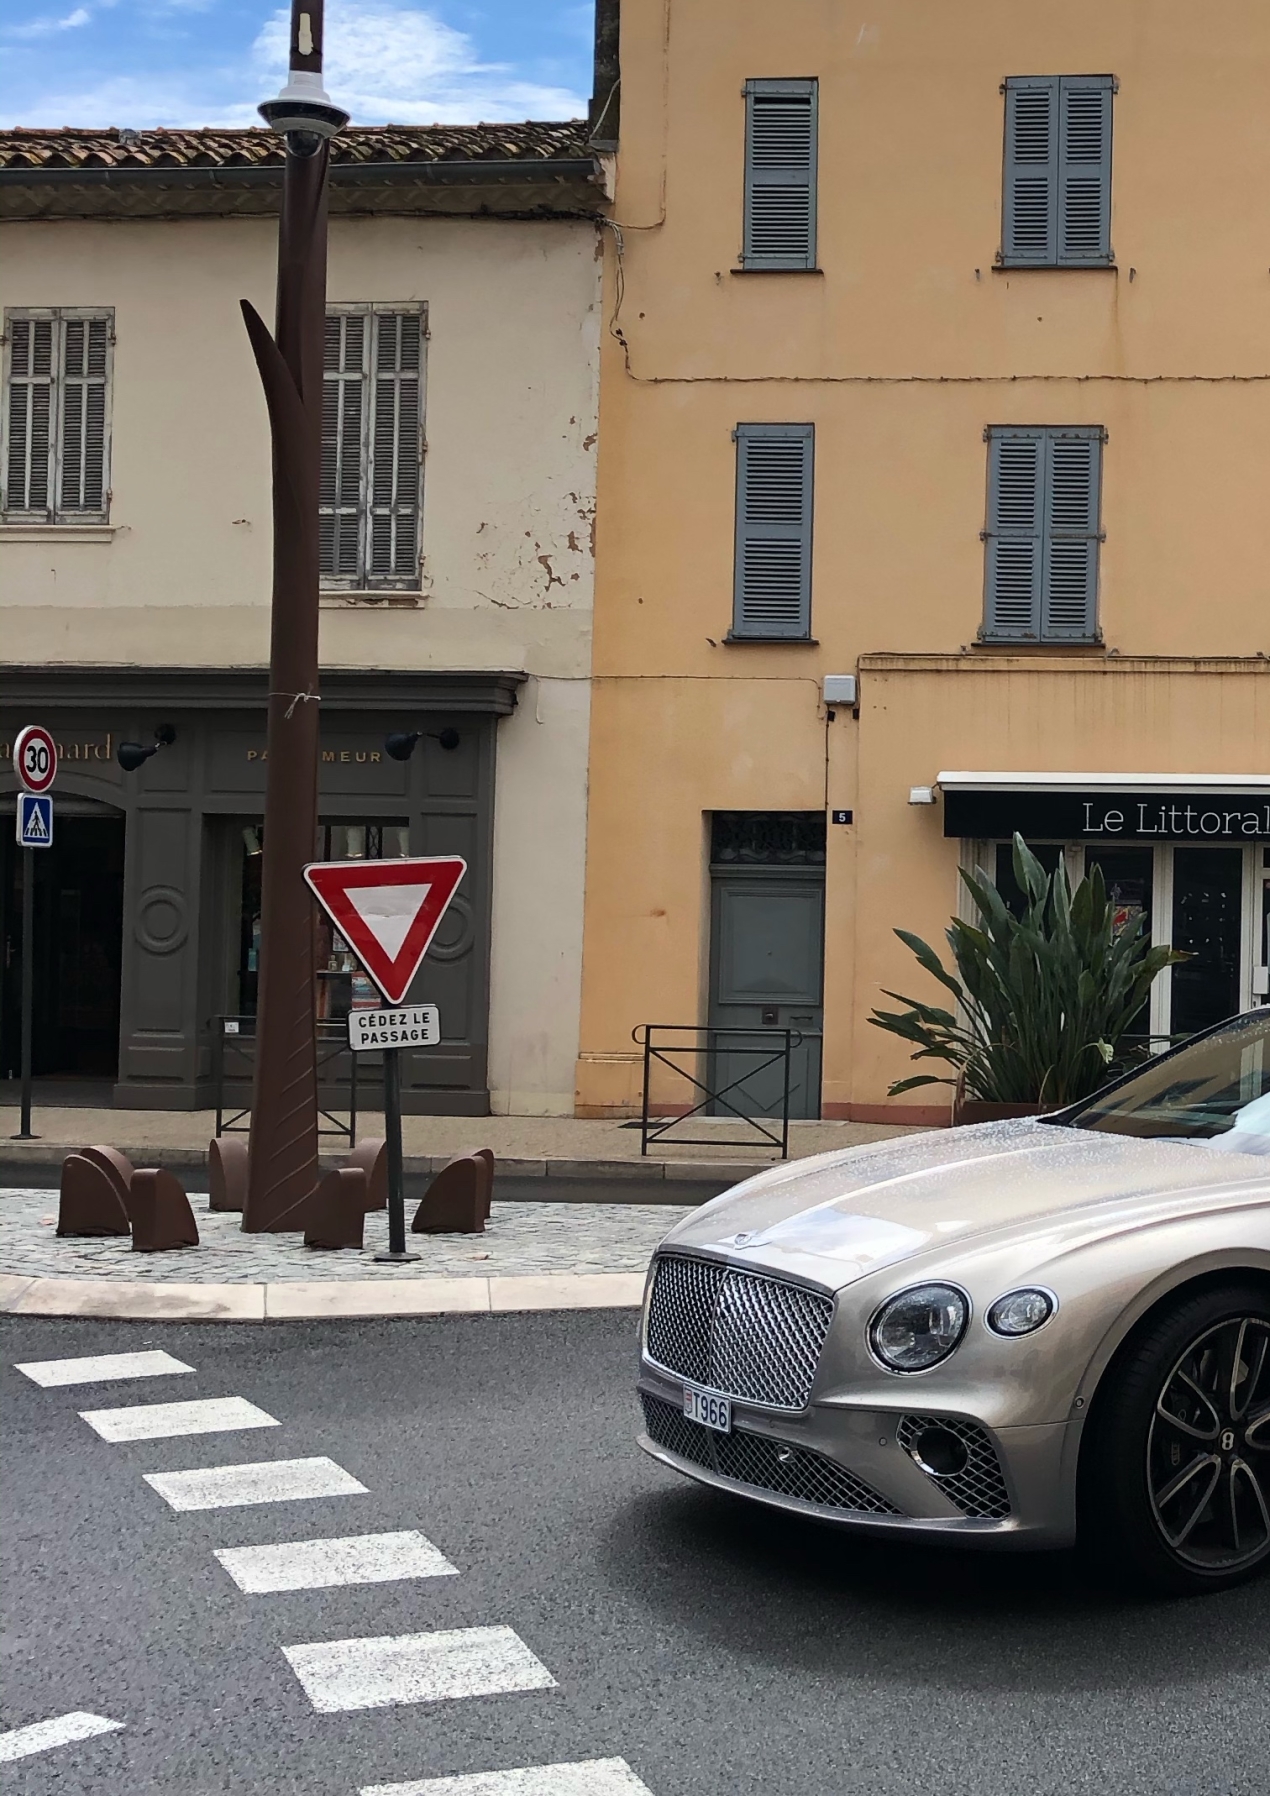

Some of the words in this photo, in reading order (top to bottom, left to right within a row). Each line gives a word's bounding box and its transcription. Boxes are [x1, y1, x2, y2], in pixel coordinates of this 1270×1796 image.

[26, 745, 49, 773] 30
[247, 750, 381, 762] PAMEUR
[838, 812, 846, 822] 5
[1082, 803, 1124, 832] Le
[358, 1014, 407, 1028] CÉDEZ
[413, 1012, 430, 1024] LE
[361, 1029, 429, 1044] PASSAGE
[693, 1391, 727, 1428] T966
